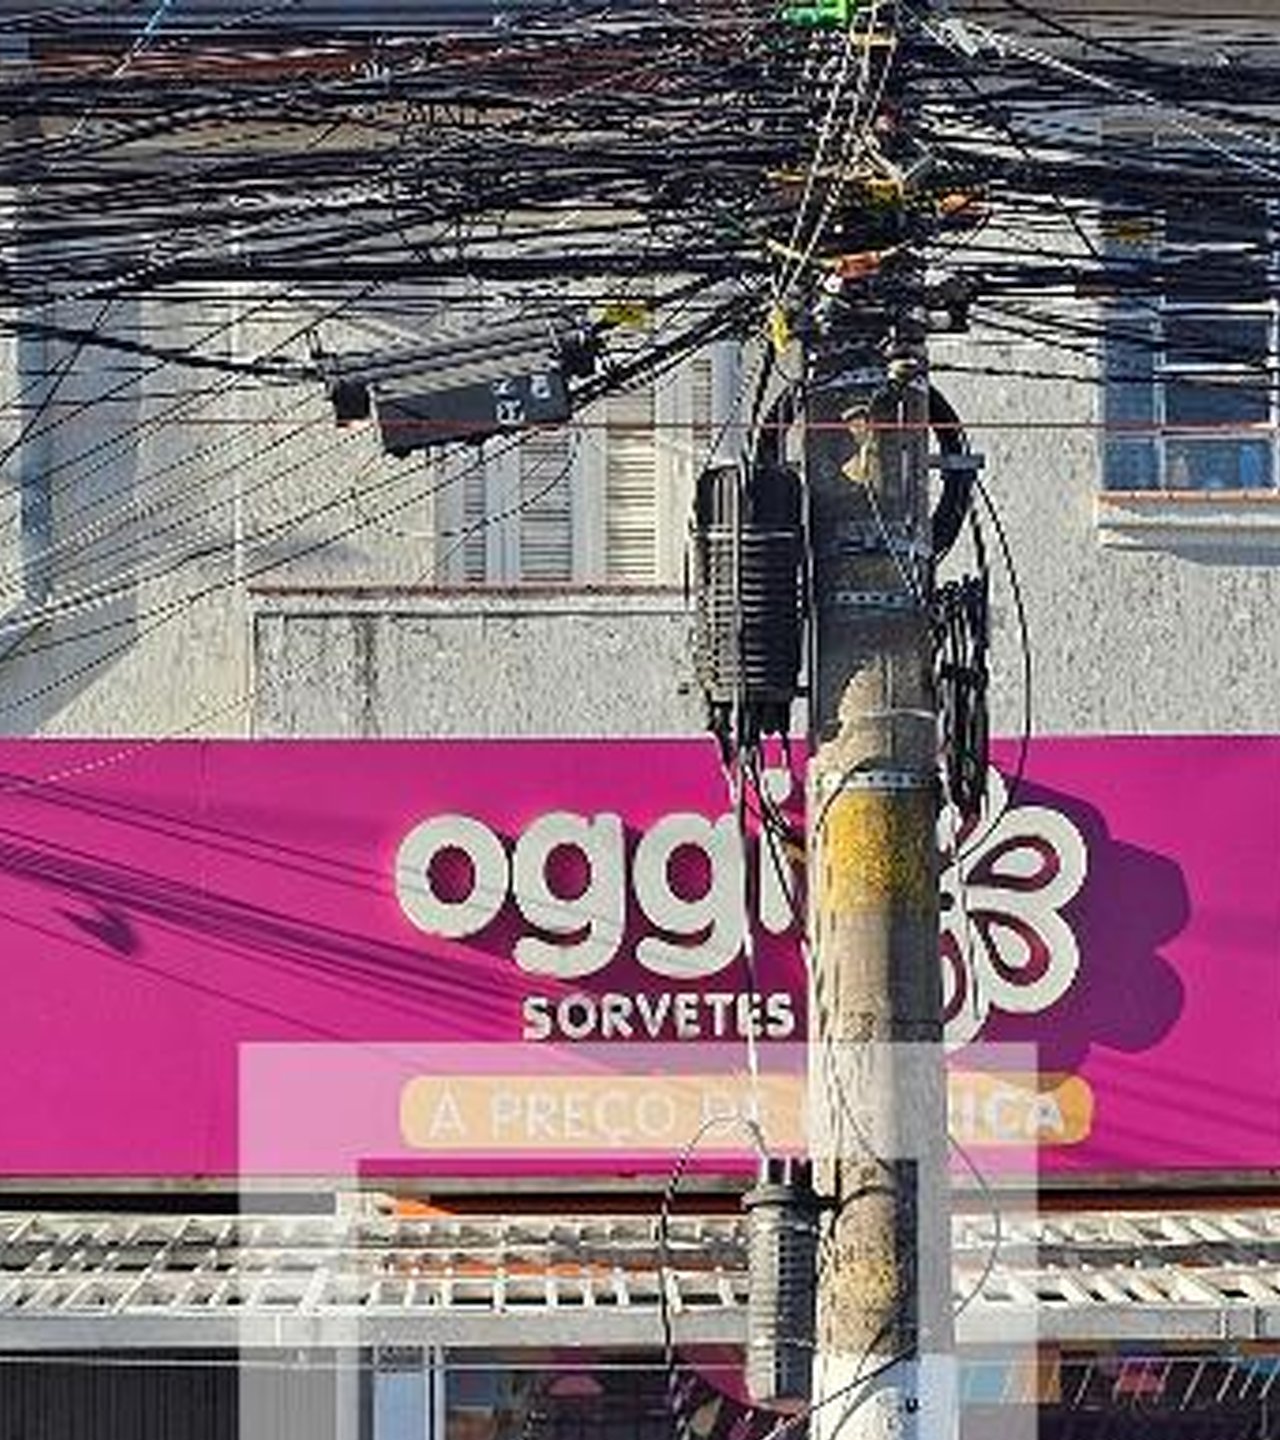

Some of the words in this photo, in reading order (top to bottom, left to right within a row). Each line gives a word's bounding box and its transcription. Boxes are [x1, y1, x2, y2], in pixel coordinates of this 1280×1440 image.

[394, 767, 795, 980] oggi
[522, 992, 796, 1041] SORVETES
[490, 1088, 677, 1146] PREÇO
